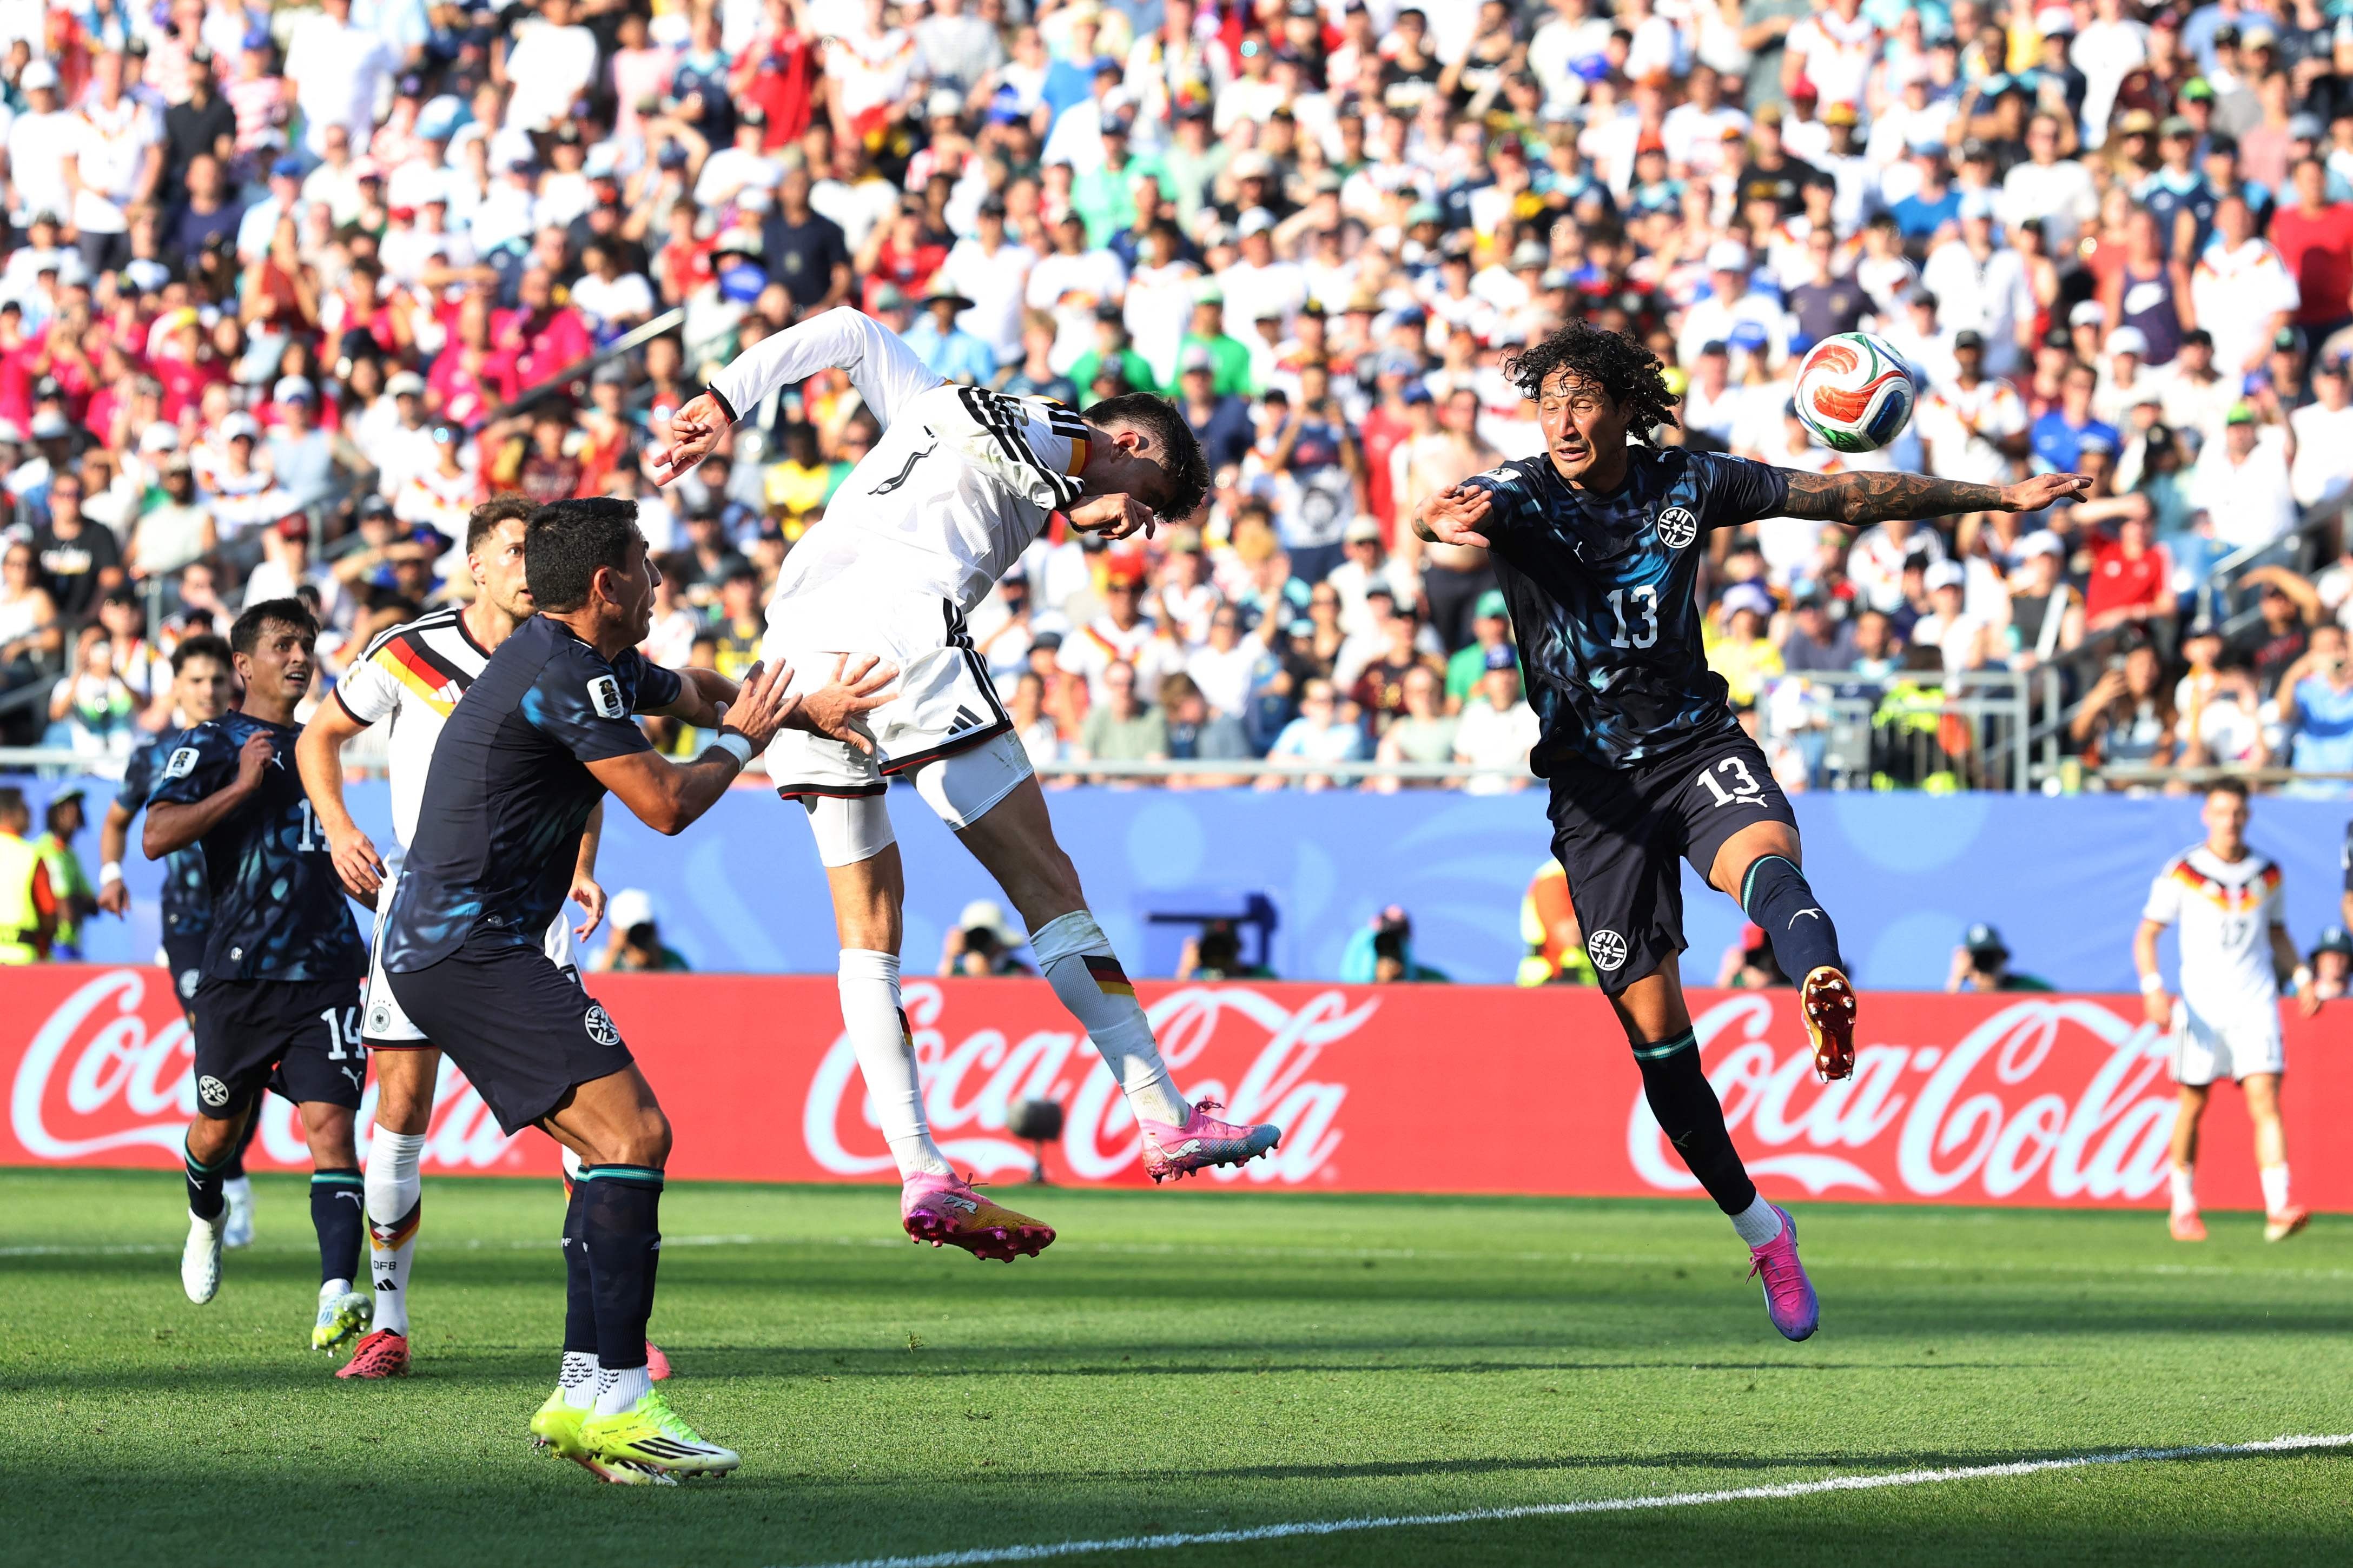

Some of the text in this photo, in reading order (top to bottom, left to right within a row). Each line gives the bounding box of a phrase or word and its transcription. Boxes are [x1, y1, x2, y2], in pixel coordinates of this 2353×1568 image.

[1666, 510, 1678, 520] APF
[1606, 584, 1658, 649] 13
[1696, 756, 1760, 808] 13
[2220, 919, 2248, 948] 17
[320, 1007, 366, 1061] 14
[373, 1260, 397, 1271] DFB
